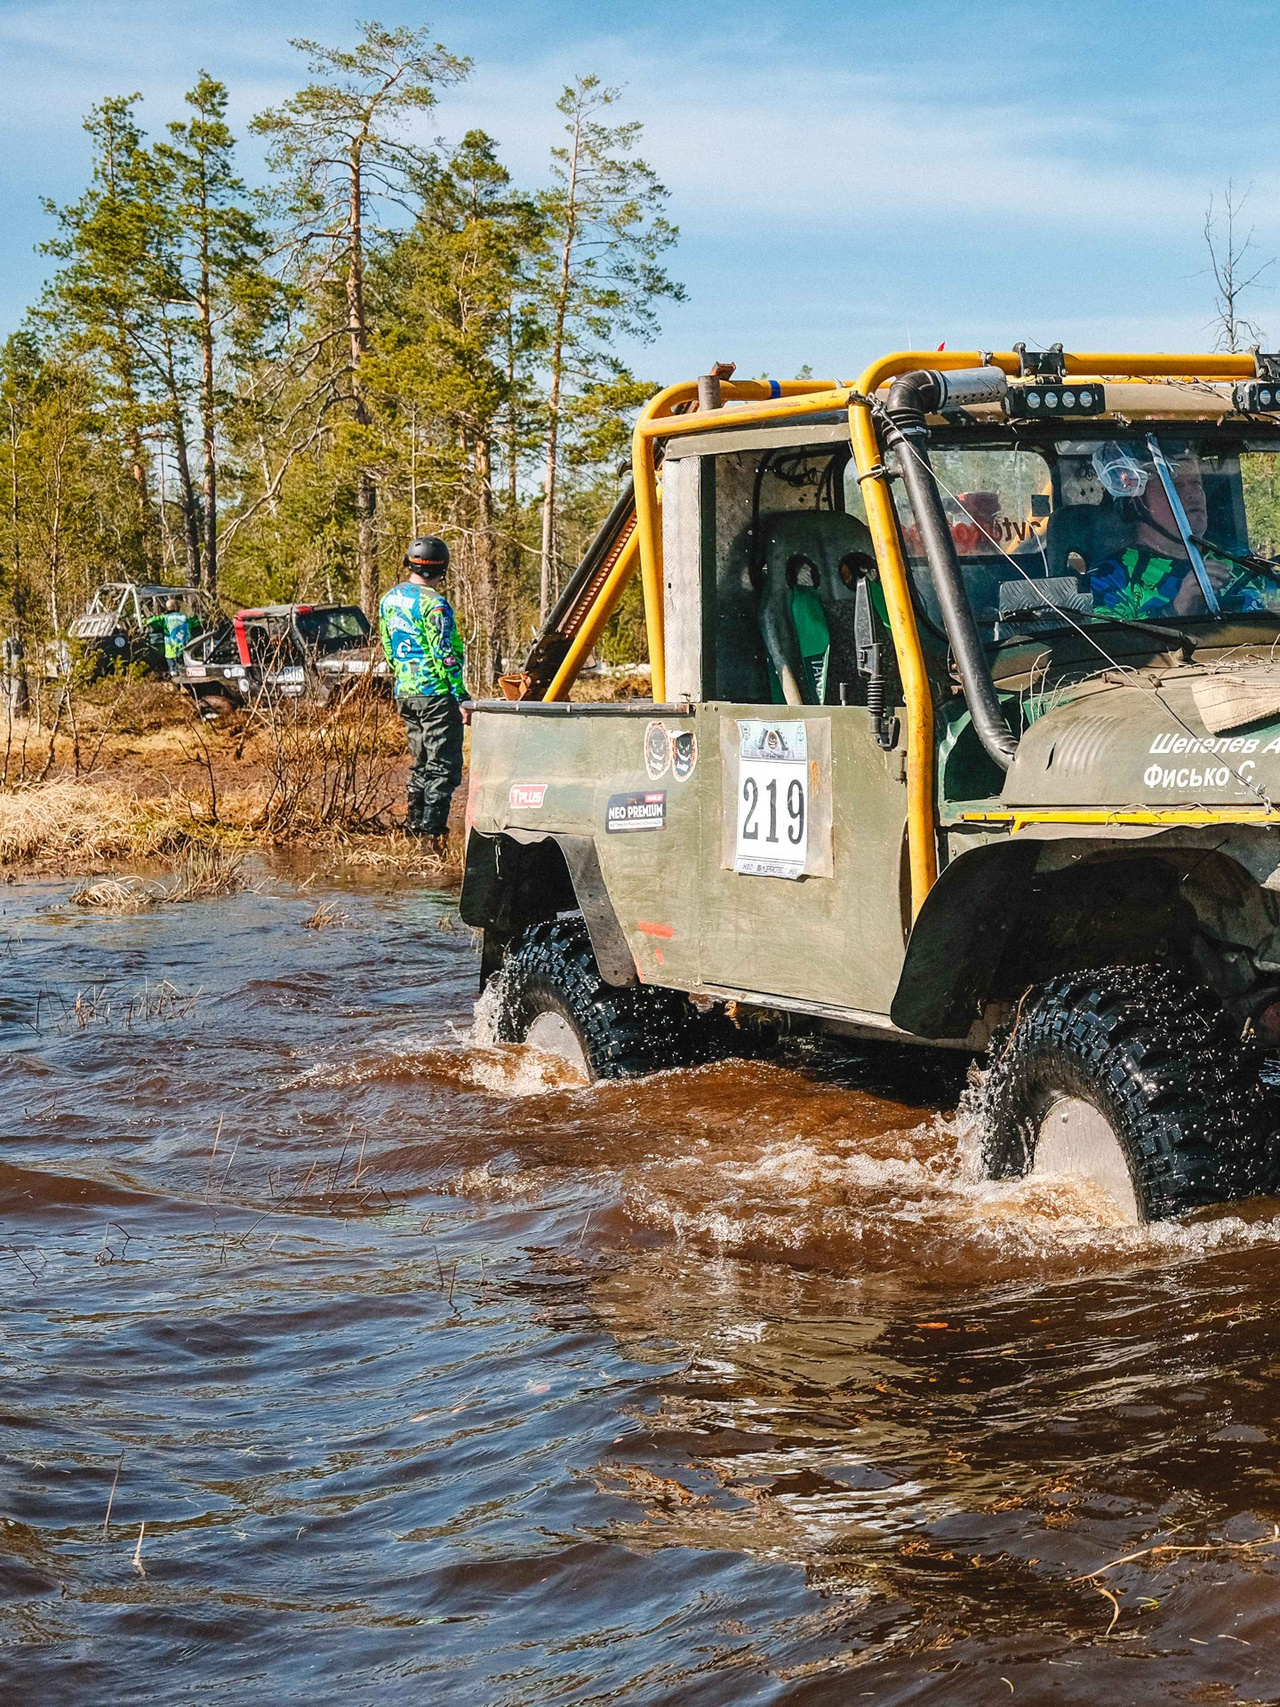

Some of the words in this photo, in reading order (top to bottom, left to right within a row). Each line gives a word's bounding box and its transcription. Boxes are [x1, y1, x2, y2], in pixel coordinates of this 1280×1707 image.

[1149, 733, 1260, 754] Шепелев
[1143, 763, 1230, 789] Фисько
[1237, 760, 1256, 787] С
[608, 806, 626, 820] NEO
[627, 803, 663, 818] PREMIUM
[743, 776, 805, 845] 219
